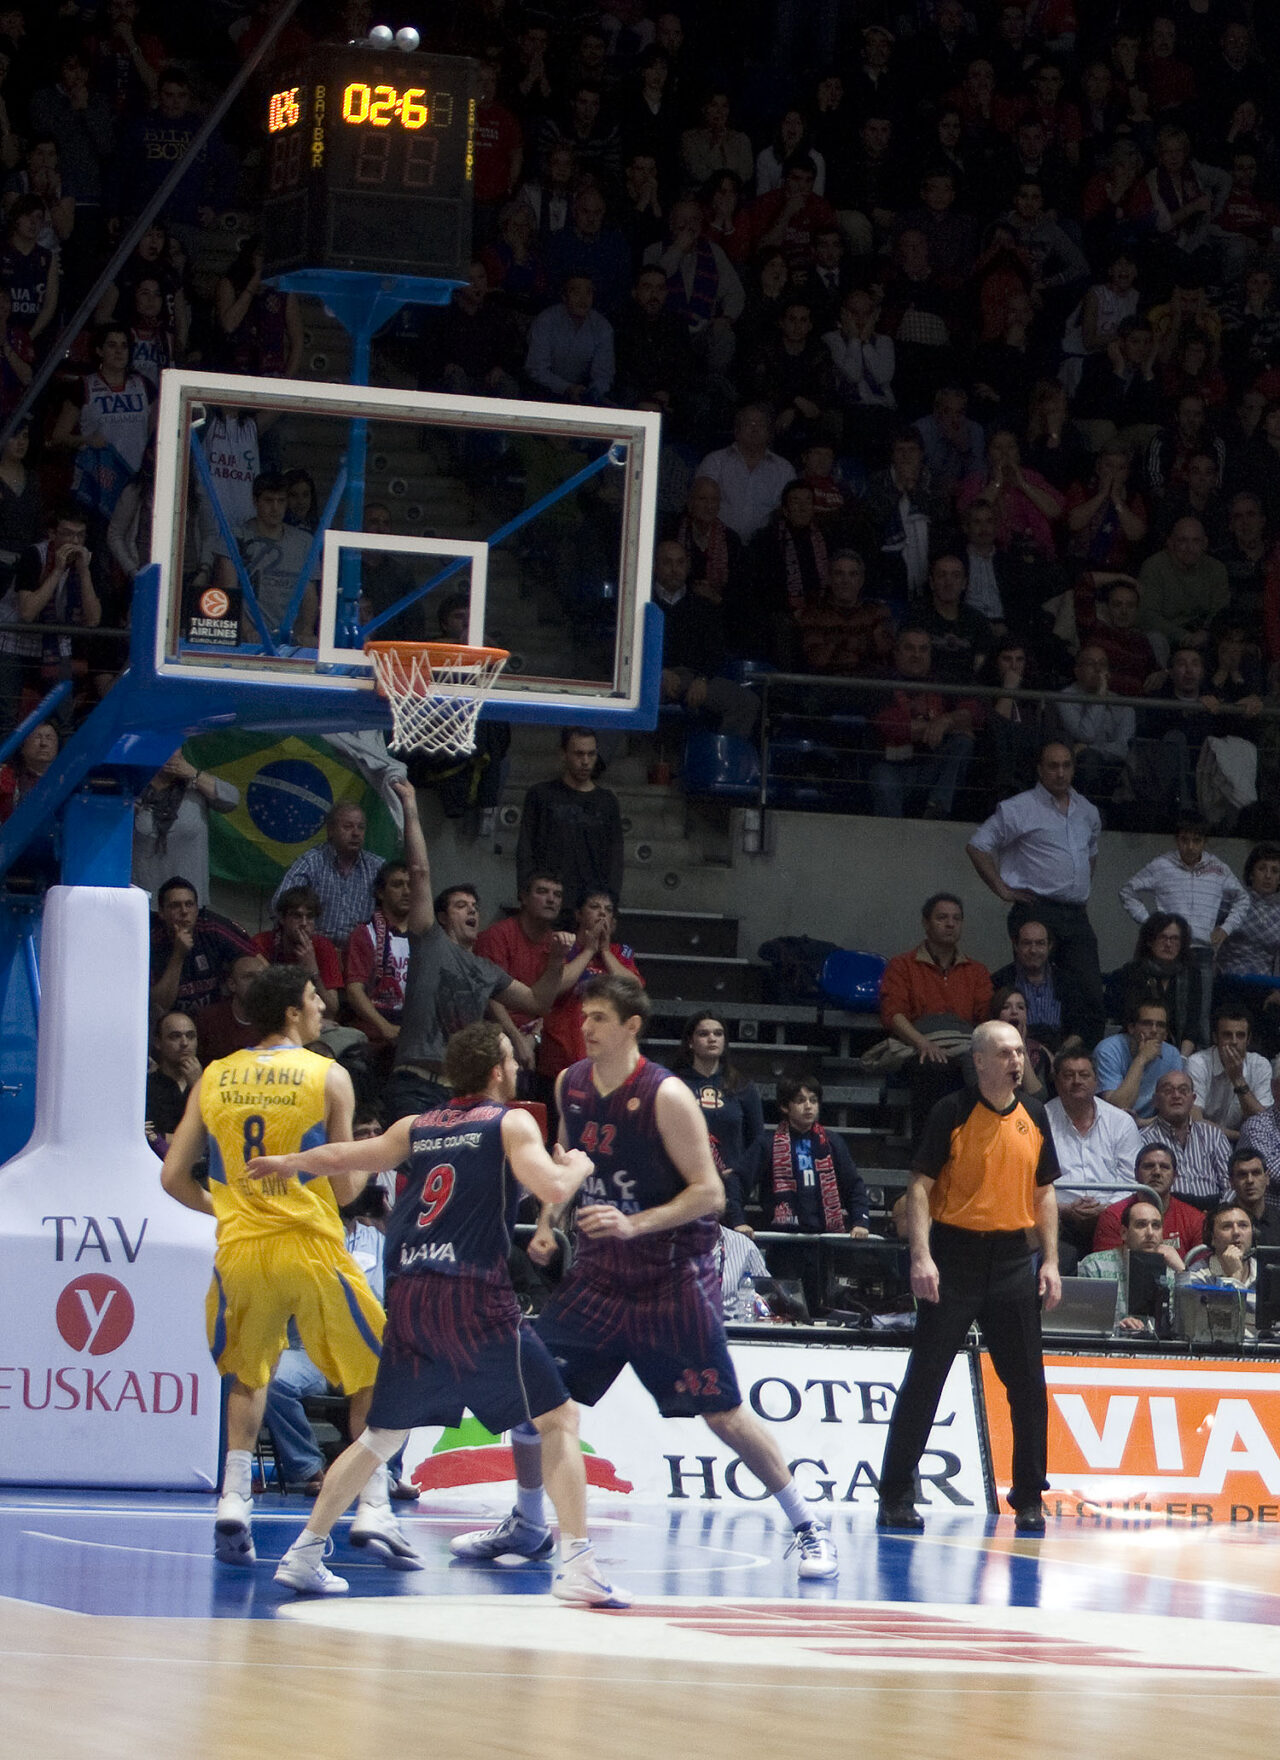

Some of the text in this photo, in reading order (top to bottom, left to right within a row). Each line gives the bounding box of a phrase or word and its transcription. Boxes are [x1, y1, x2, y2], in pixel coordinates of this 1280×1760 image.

[95, 393, 144, 414] TAU
[189, 627, 237, 639] AIRLINES
[191, 617, 238, 630] TURKISH
[219, 1066, 304, 1088] ELIYAHU
[220, 1090, 297, 1108] Whirlpool
[243, 1114, 267, 1166] 8
[580, 1120, 617, 1156] 42
[418, 1162, 456, 1228] 9
[42, 1216, 148, 1263] TAV
[663, 1448, 975, 1506] HOGAR
[1230, 1504, 1278, 1524] DE
